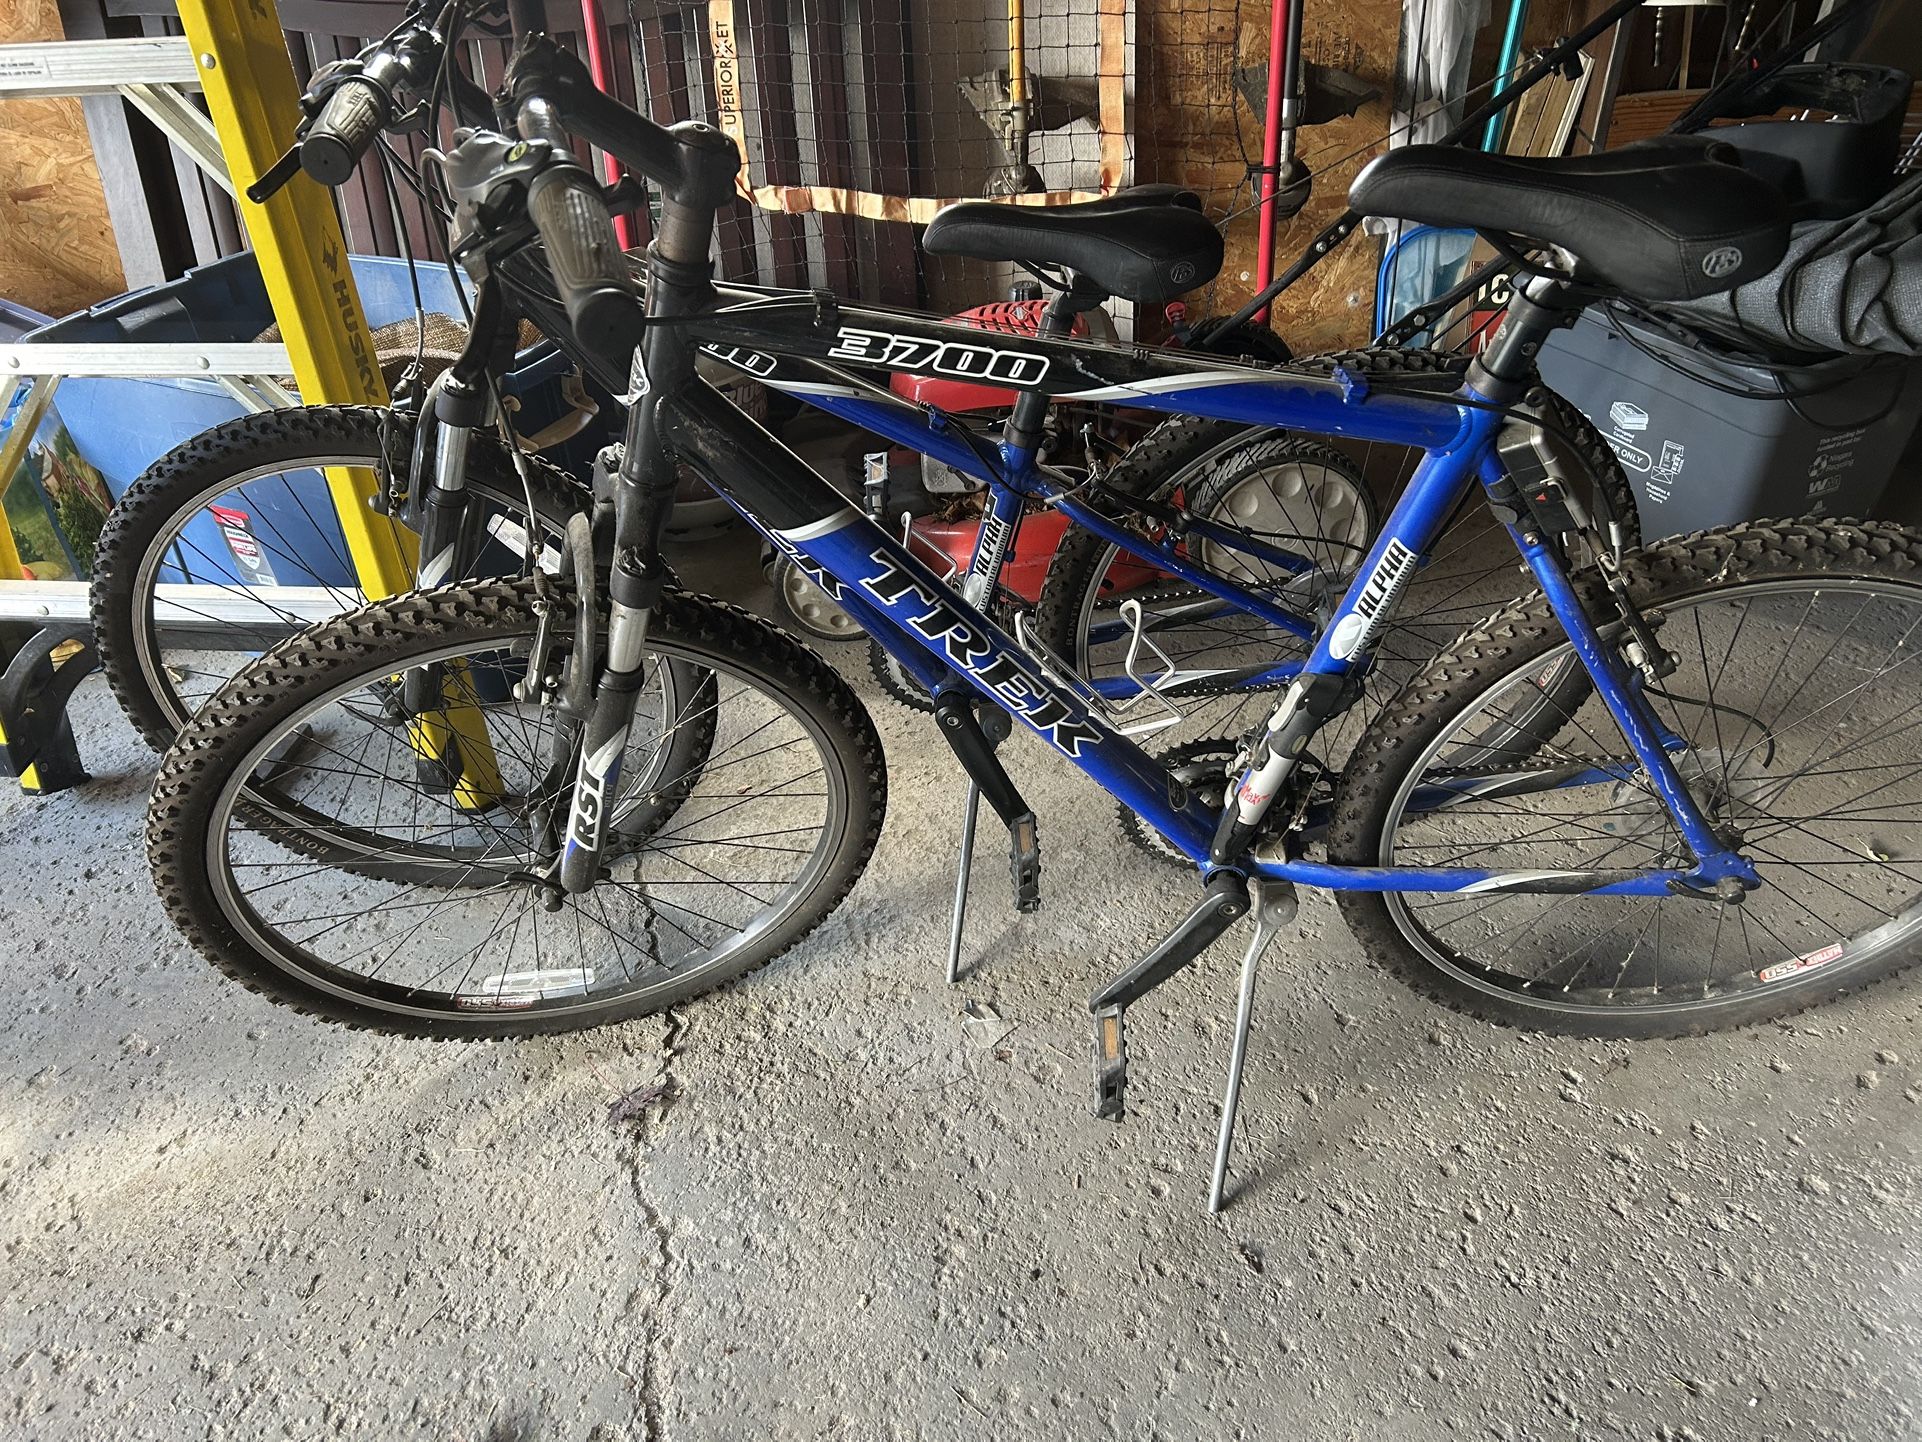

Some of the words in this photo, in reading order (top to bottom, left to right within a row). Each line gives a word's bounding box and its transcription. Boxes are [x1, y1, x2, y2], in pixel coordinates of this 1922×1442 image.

[332, 279, 379, 403] HUSKY
[827, 326, 1050, 386] 3700
[1621, 448, 1643, 465] ONLY
[976, 516, 1004, 577] ALPHA
[1357, 541, 1409, 620] ALPHA
[858, 547, 1104, 758] TREK
[241, 803, 330, 855] BONTRAGER
[573, 756, 602, 851] RST
